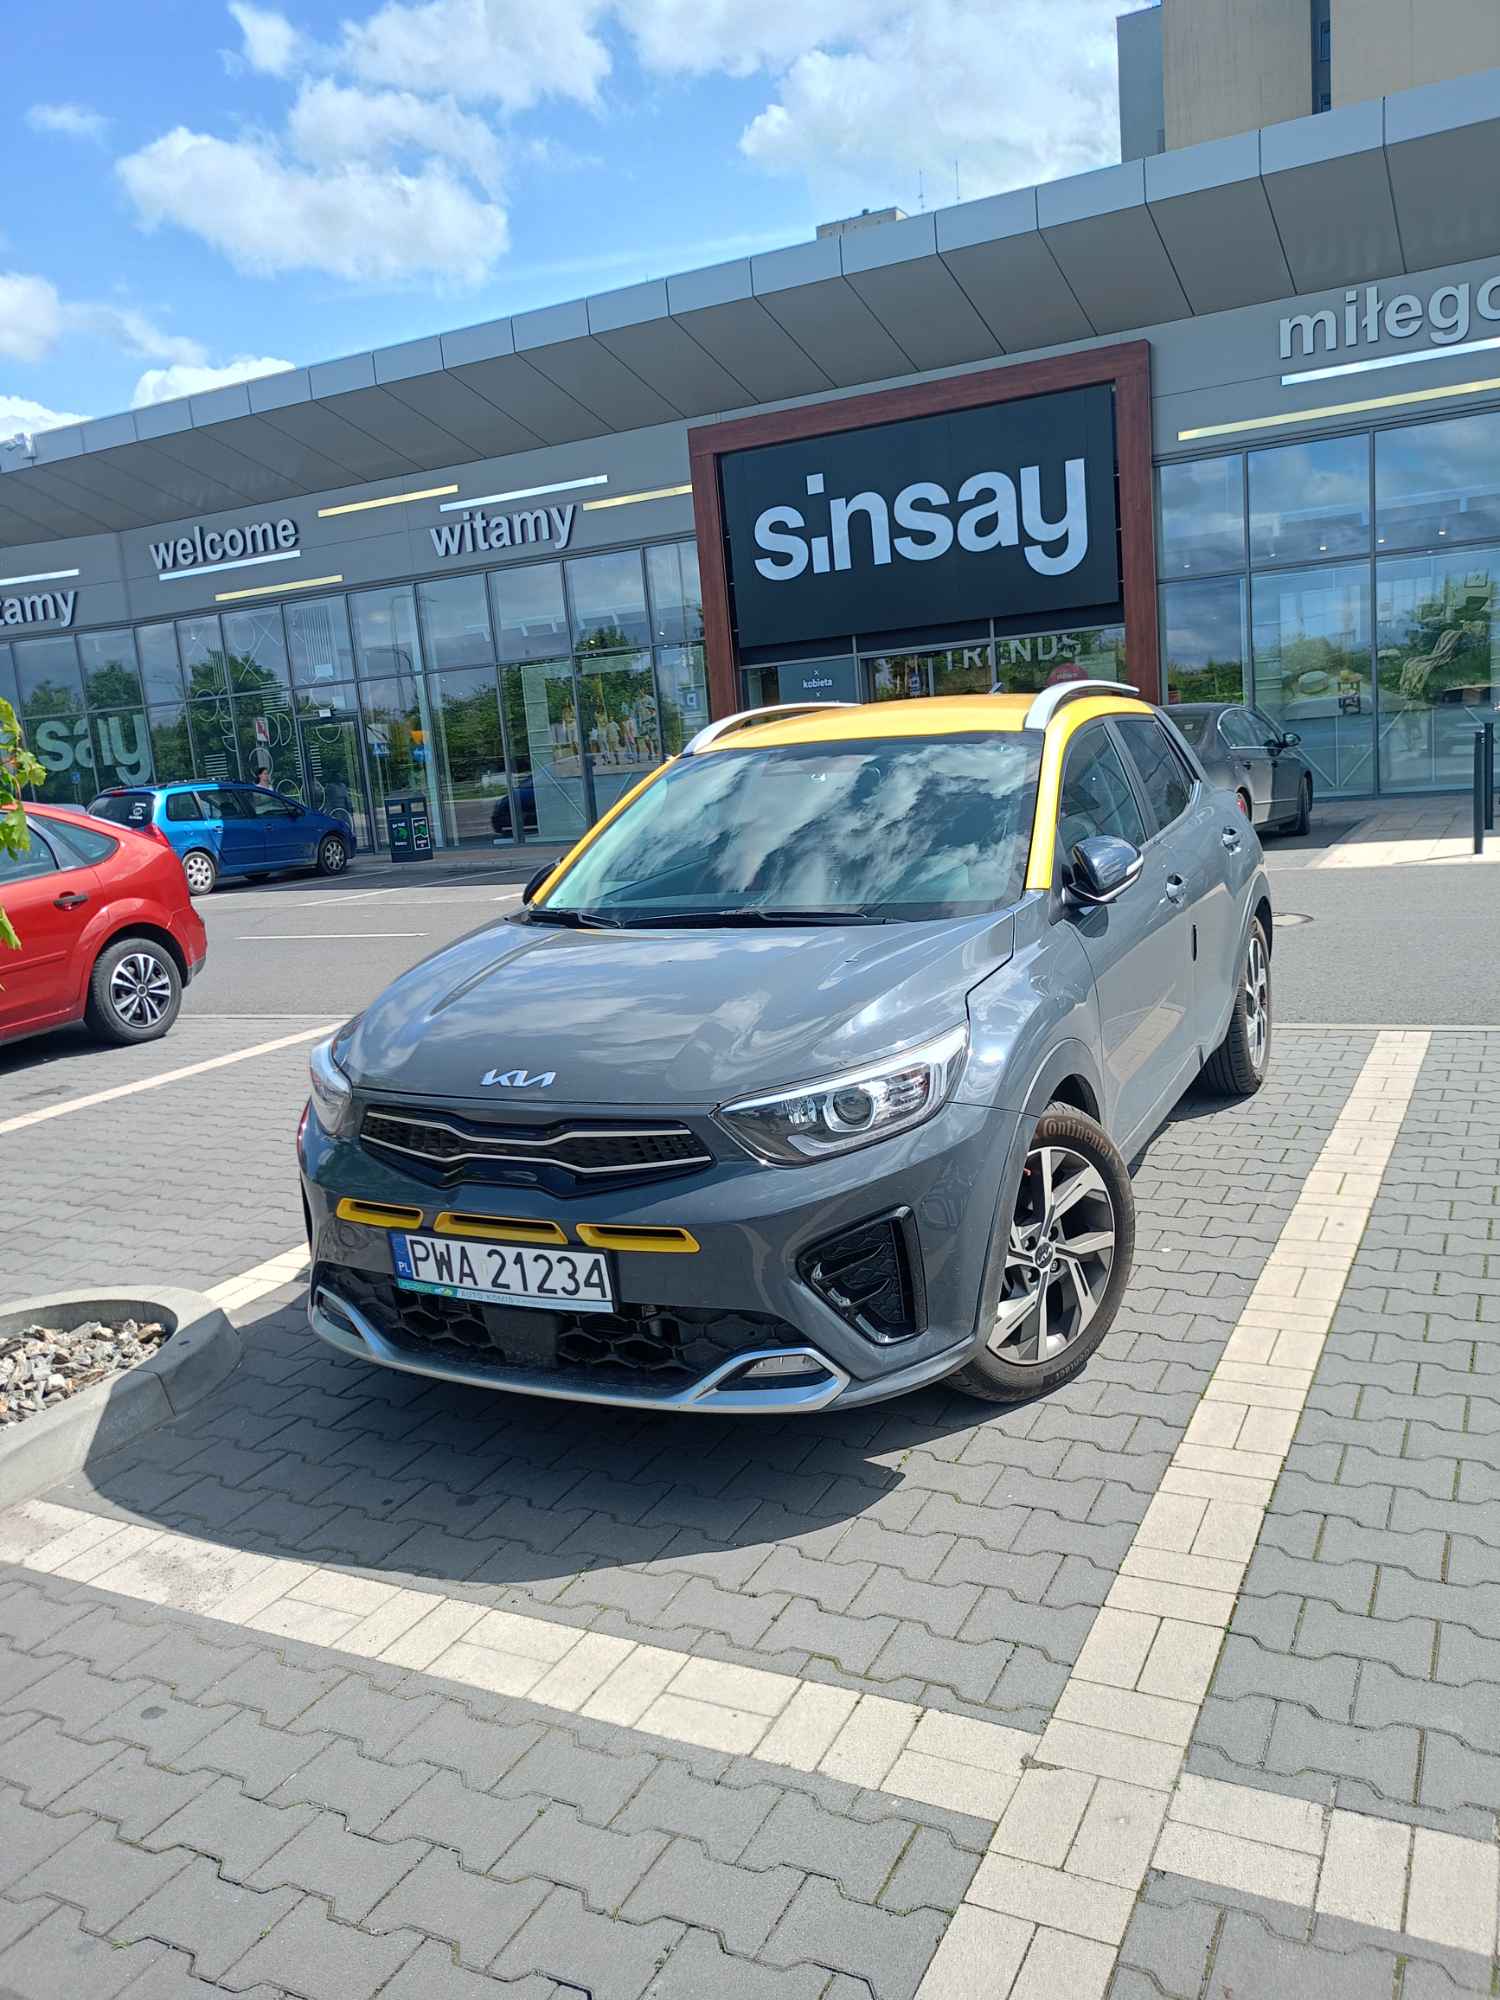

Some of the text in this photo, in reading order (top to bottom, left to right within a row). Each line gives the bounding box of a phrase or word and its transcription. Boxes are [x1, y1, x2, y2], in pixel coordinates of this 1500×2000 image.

[149, 518, 299, 570] welcome
[430, 504, 576, 557] witamy
[754, 458, 1089, 581] sinsay
[803, 678, 833, 689] kobieta
[480, 1069, 556, 1089] KIA
[398, 1261, 411, 1273] PL
[410, 1239, 607, 1298] PWA 21234
